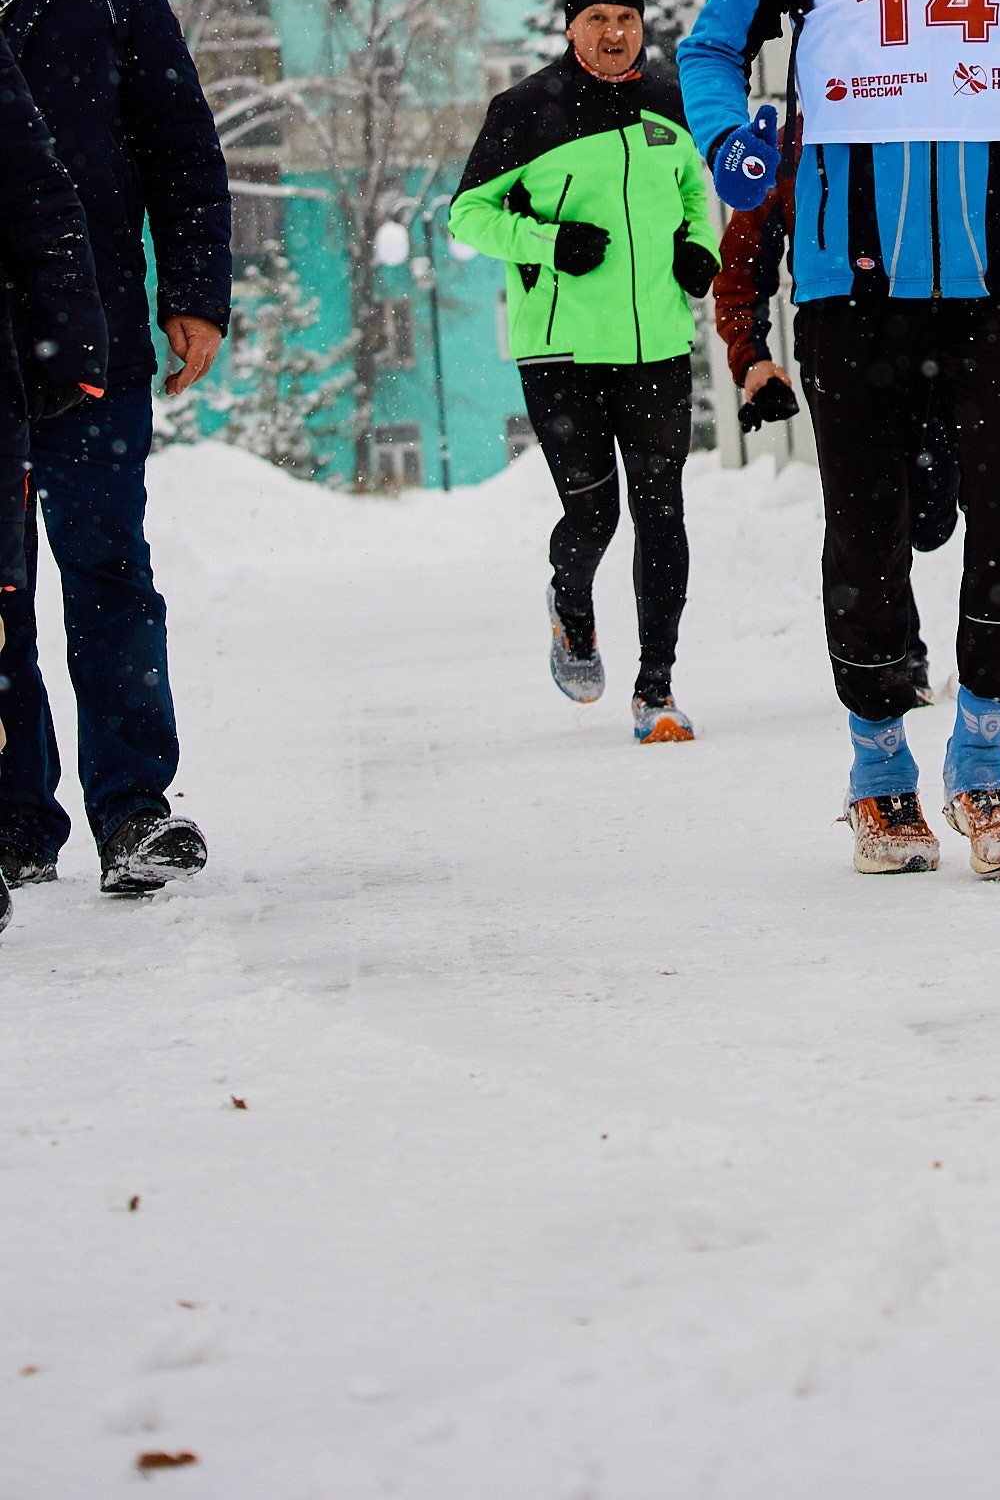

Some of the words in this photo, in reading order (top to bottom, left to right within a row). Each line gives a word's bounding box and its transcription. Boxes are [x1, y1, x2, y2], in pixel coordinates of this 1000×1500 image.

[851, 72, 928, 87] ВЕРТОЛЕТЫ
[852, 86, 903, 98] РОССИИ
[724, 139, 741, 170] ЖИЗНИ
